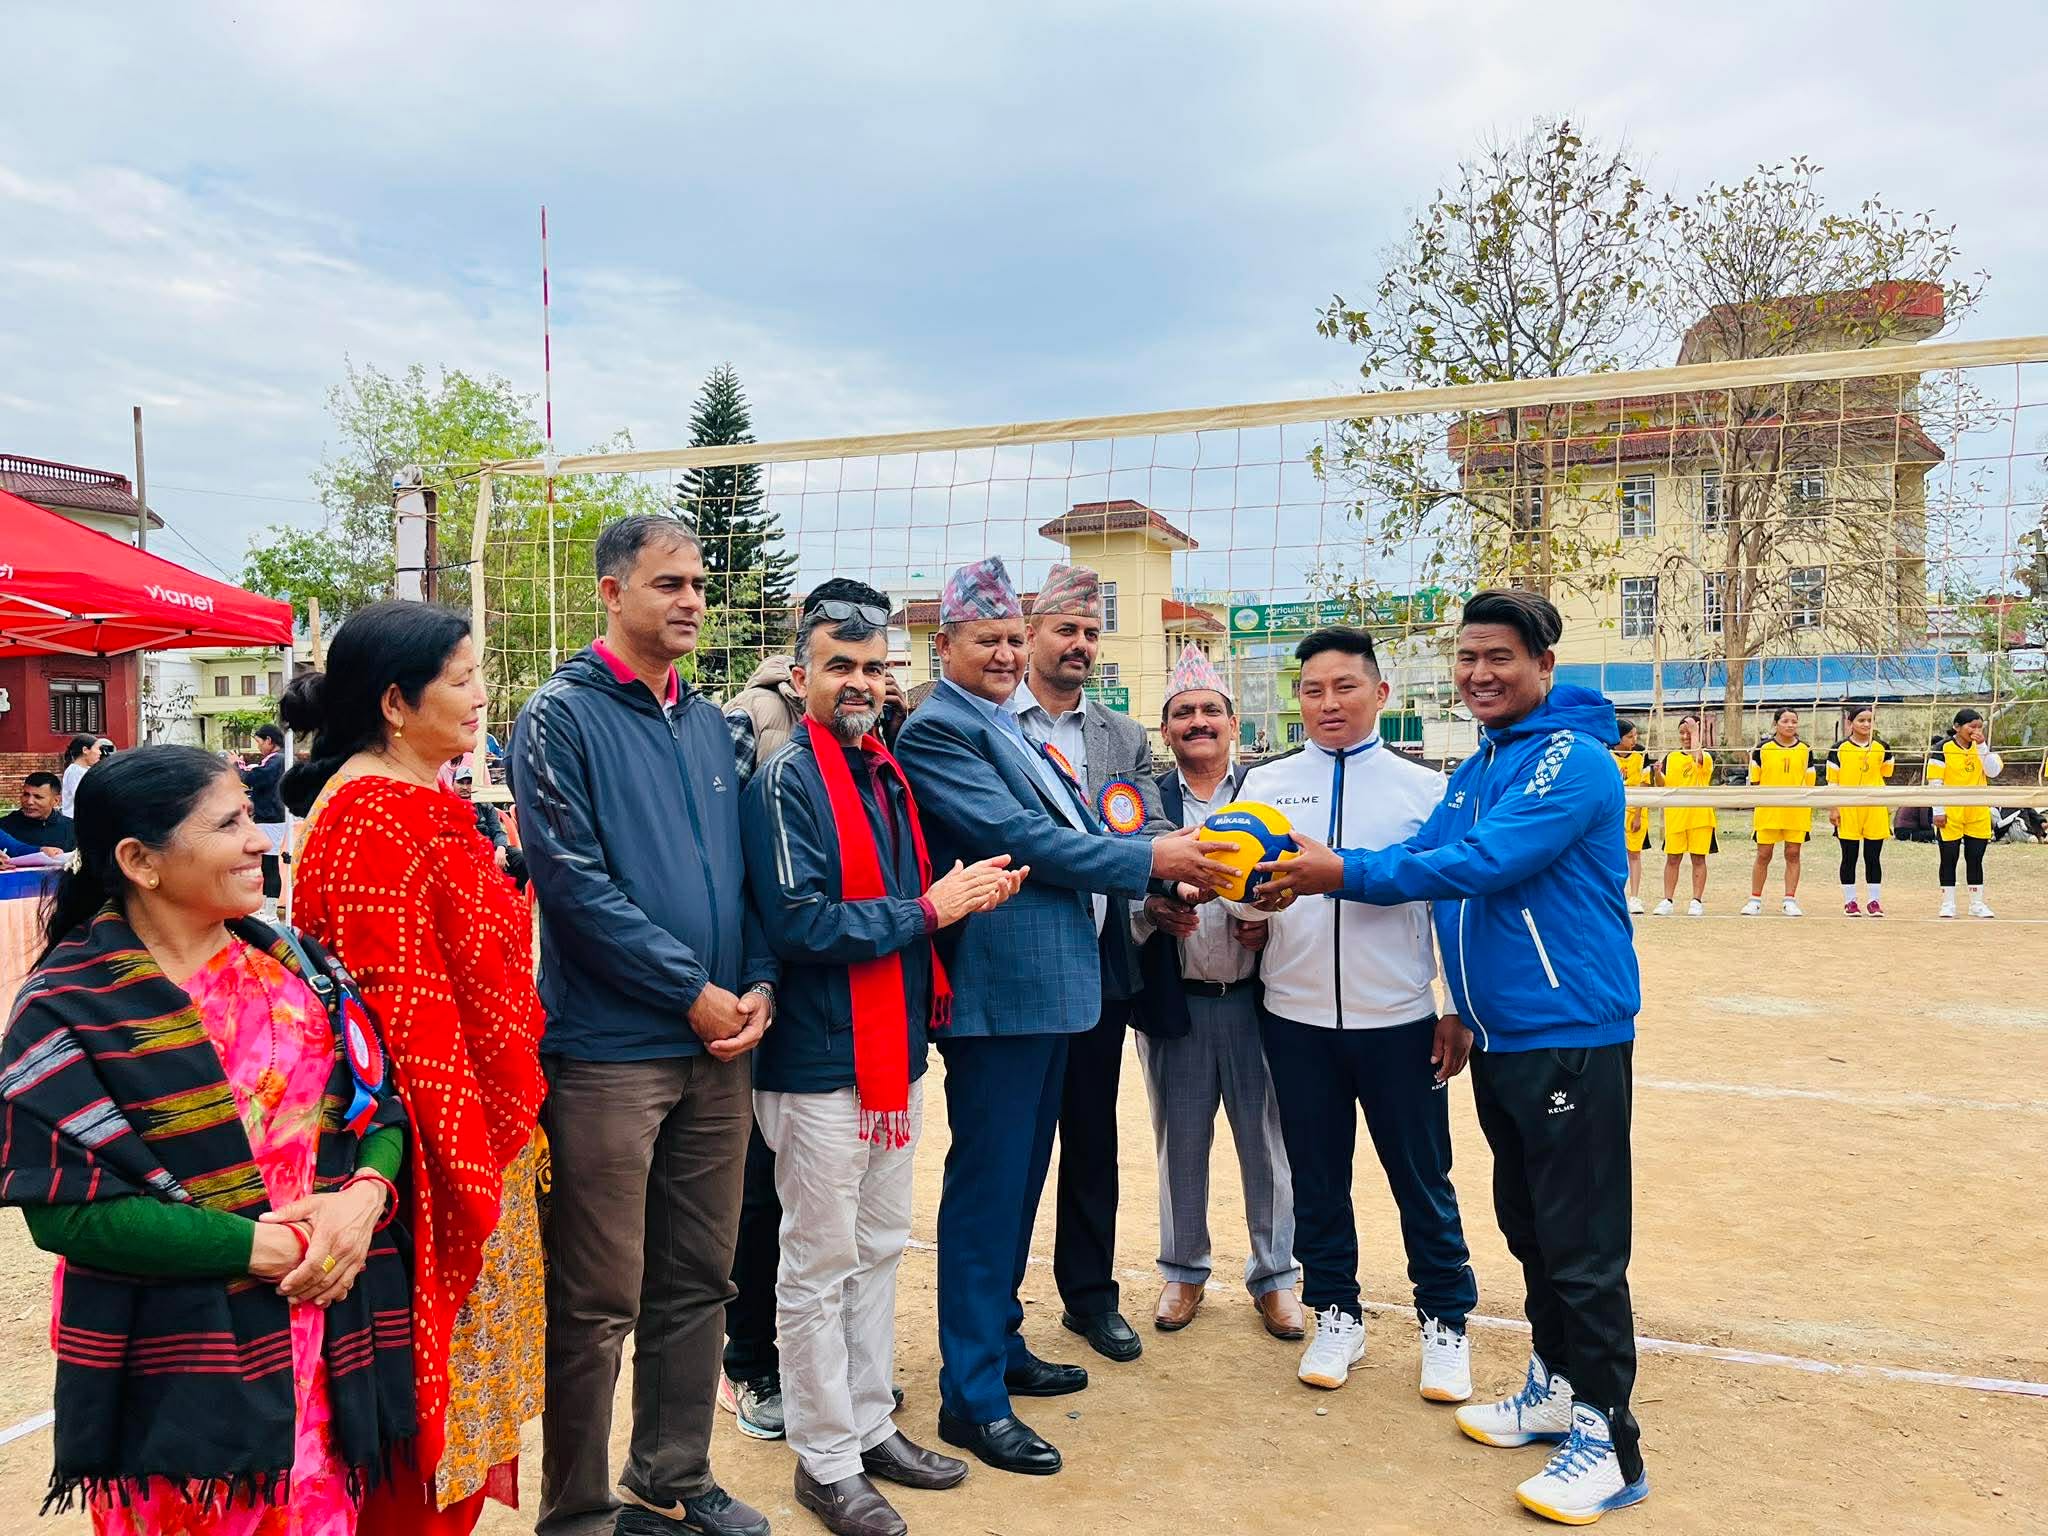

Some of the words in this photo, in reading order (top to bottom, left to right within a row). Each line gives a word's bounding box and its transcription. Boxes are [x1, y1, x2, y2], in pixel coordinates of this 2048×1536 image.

[144, 584, 214, 613] vianet
[1265, 604, 1316, 616] Agricultural
[1276, 795, 1321, 805] KELME
[1214, 815, 1251, 826] MIKASA
[1547, 1103, 1576, 1115] KELME
